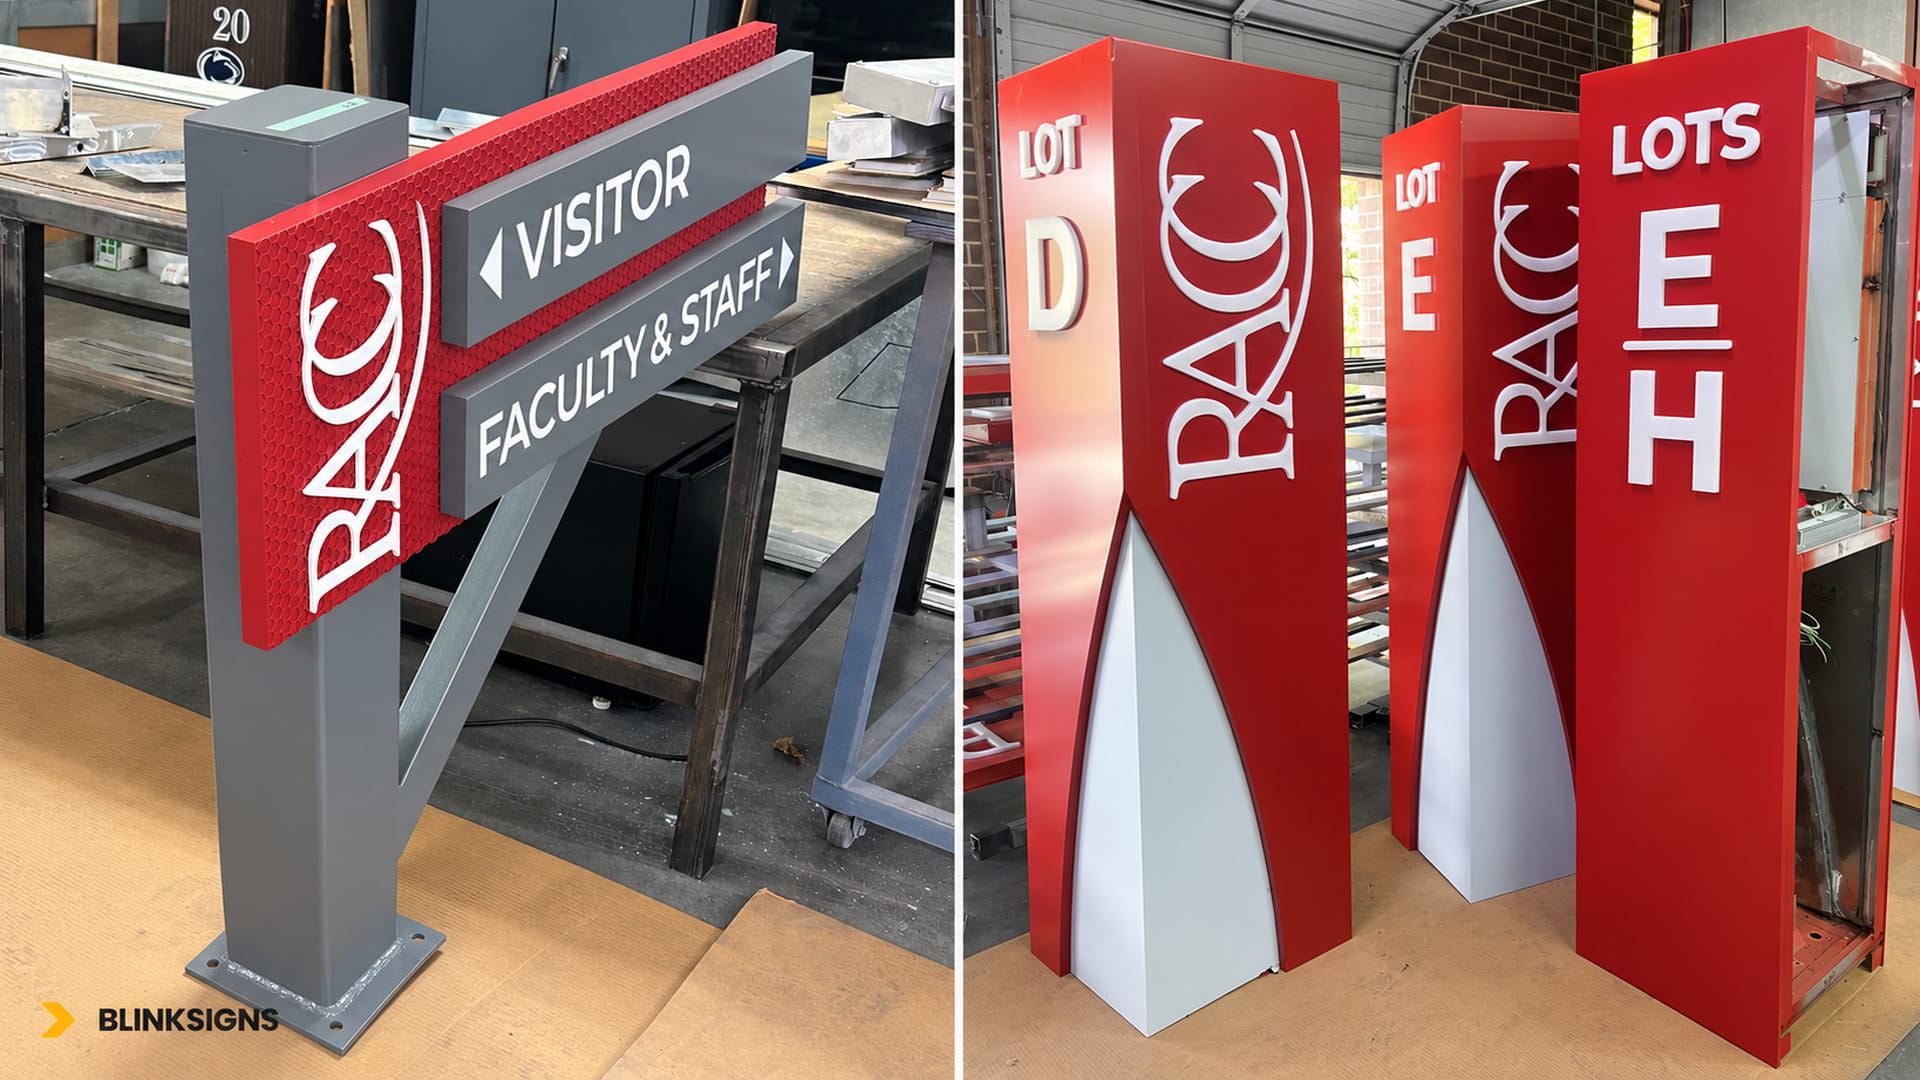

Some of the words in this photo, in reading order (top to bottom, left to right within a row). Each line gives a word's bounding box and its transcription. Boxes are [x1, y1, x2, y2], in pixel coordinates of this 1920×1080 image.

[213, 6, 250, 44] 20
[1018, 114, 1083, 179] LOT
[1395, 162, 1441, 211] LOT
[1612, 102, 1761, 176] LOTS
[516, 145, 690, 280] VISITOR
[1638, 204, 1720, 329] E
[1026, 216, 1085, 332] D
[1159, 117, 1313, 500] RACC
[1401, 238, 1436, 331] E
[300, 200, 431, 614] RACC
[479, 324, 646, 478] FACULTY
[650, 313, 673, 365] &
[680, 247, 774, 345] STAFF
[1628, 370, 1723, 493] H
